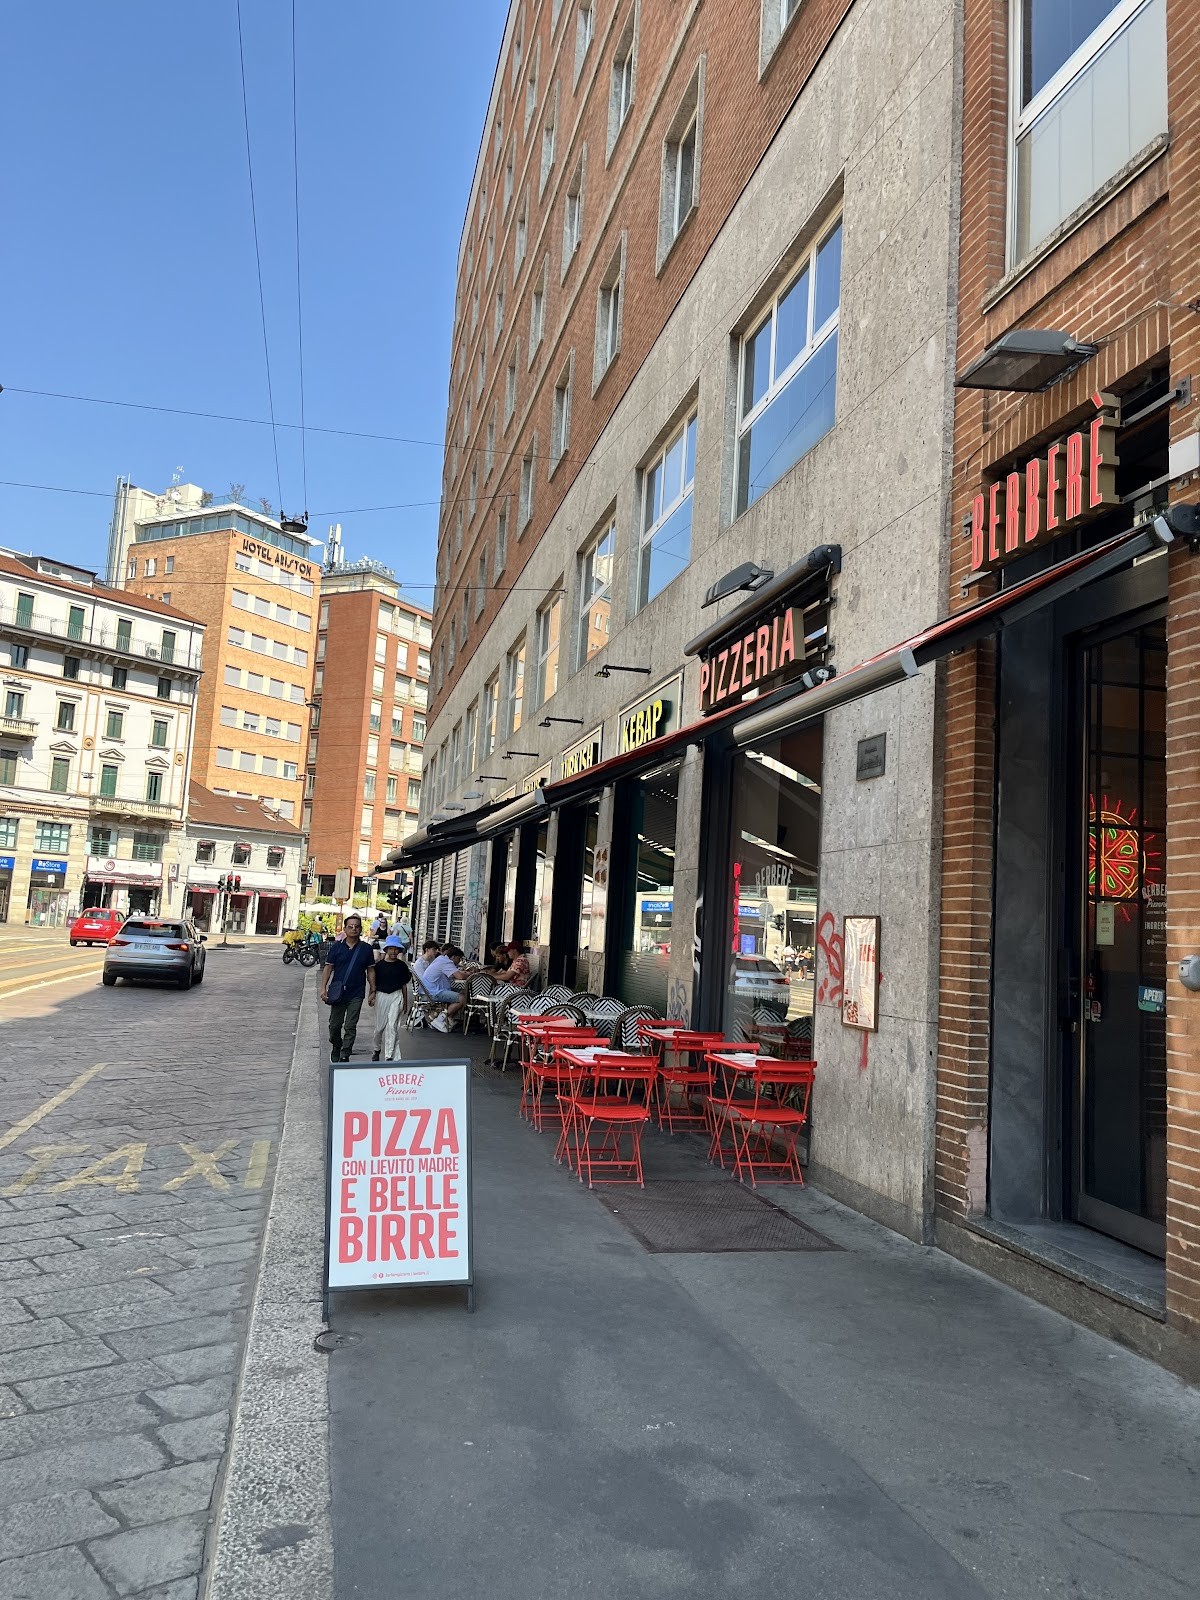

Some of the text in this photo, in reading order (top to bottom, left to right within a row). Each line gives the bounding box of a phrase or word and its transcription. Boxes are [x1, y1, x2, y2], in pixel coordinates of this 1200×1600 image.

[971, 391, 1106, 571] BERBERÈ
[242, 538, 312, 577] HOTEL ARISTON
[699, 607, 796, 711] PIZZERIA
[622, 699, 663, 753] KEBAP
[561, 742, 594, 780] TURKISH
[755, 863, 794, 889] BERBERÈ
[378, 1072, 425, 1088] BERBERÈ
[385, 1086, 417, 1096] Pizzeria
[343, 1108, 460, 1159] PIZZA
[0, 1140, 272, 1197] TAXI
[341, 1156, 460, 1177] CON LIEVITO MADRE
[340, 1173, 459, 1214] E BELLE
[338, 1211, 460, 1264] BIRRE
